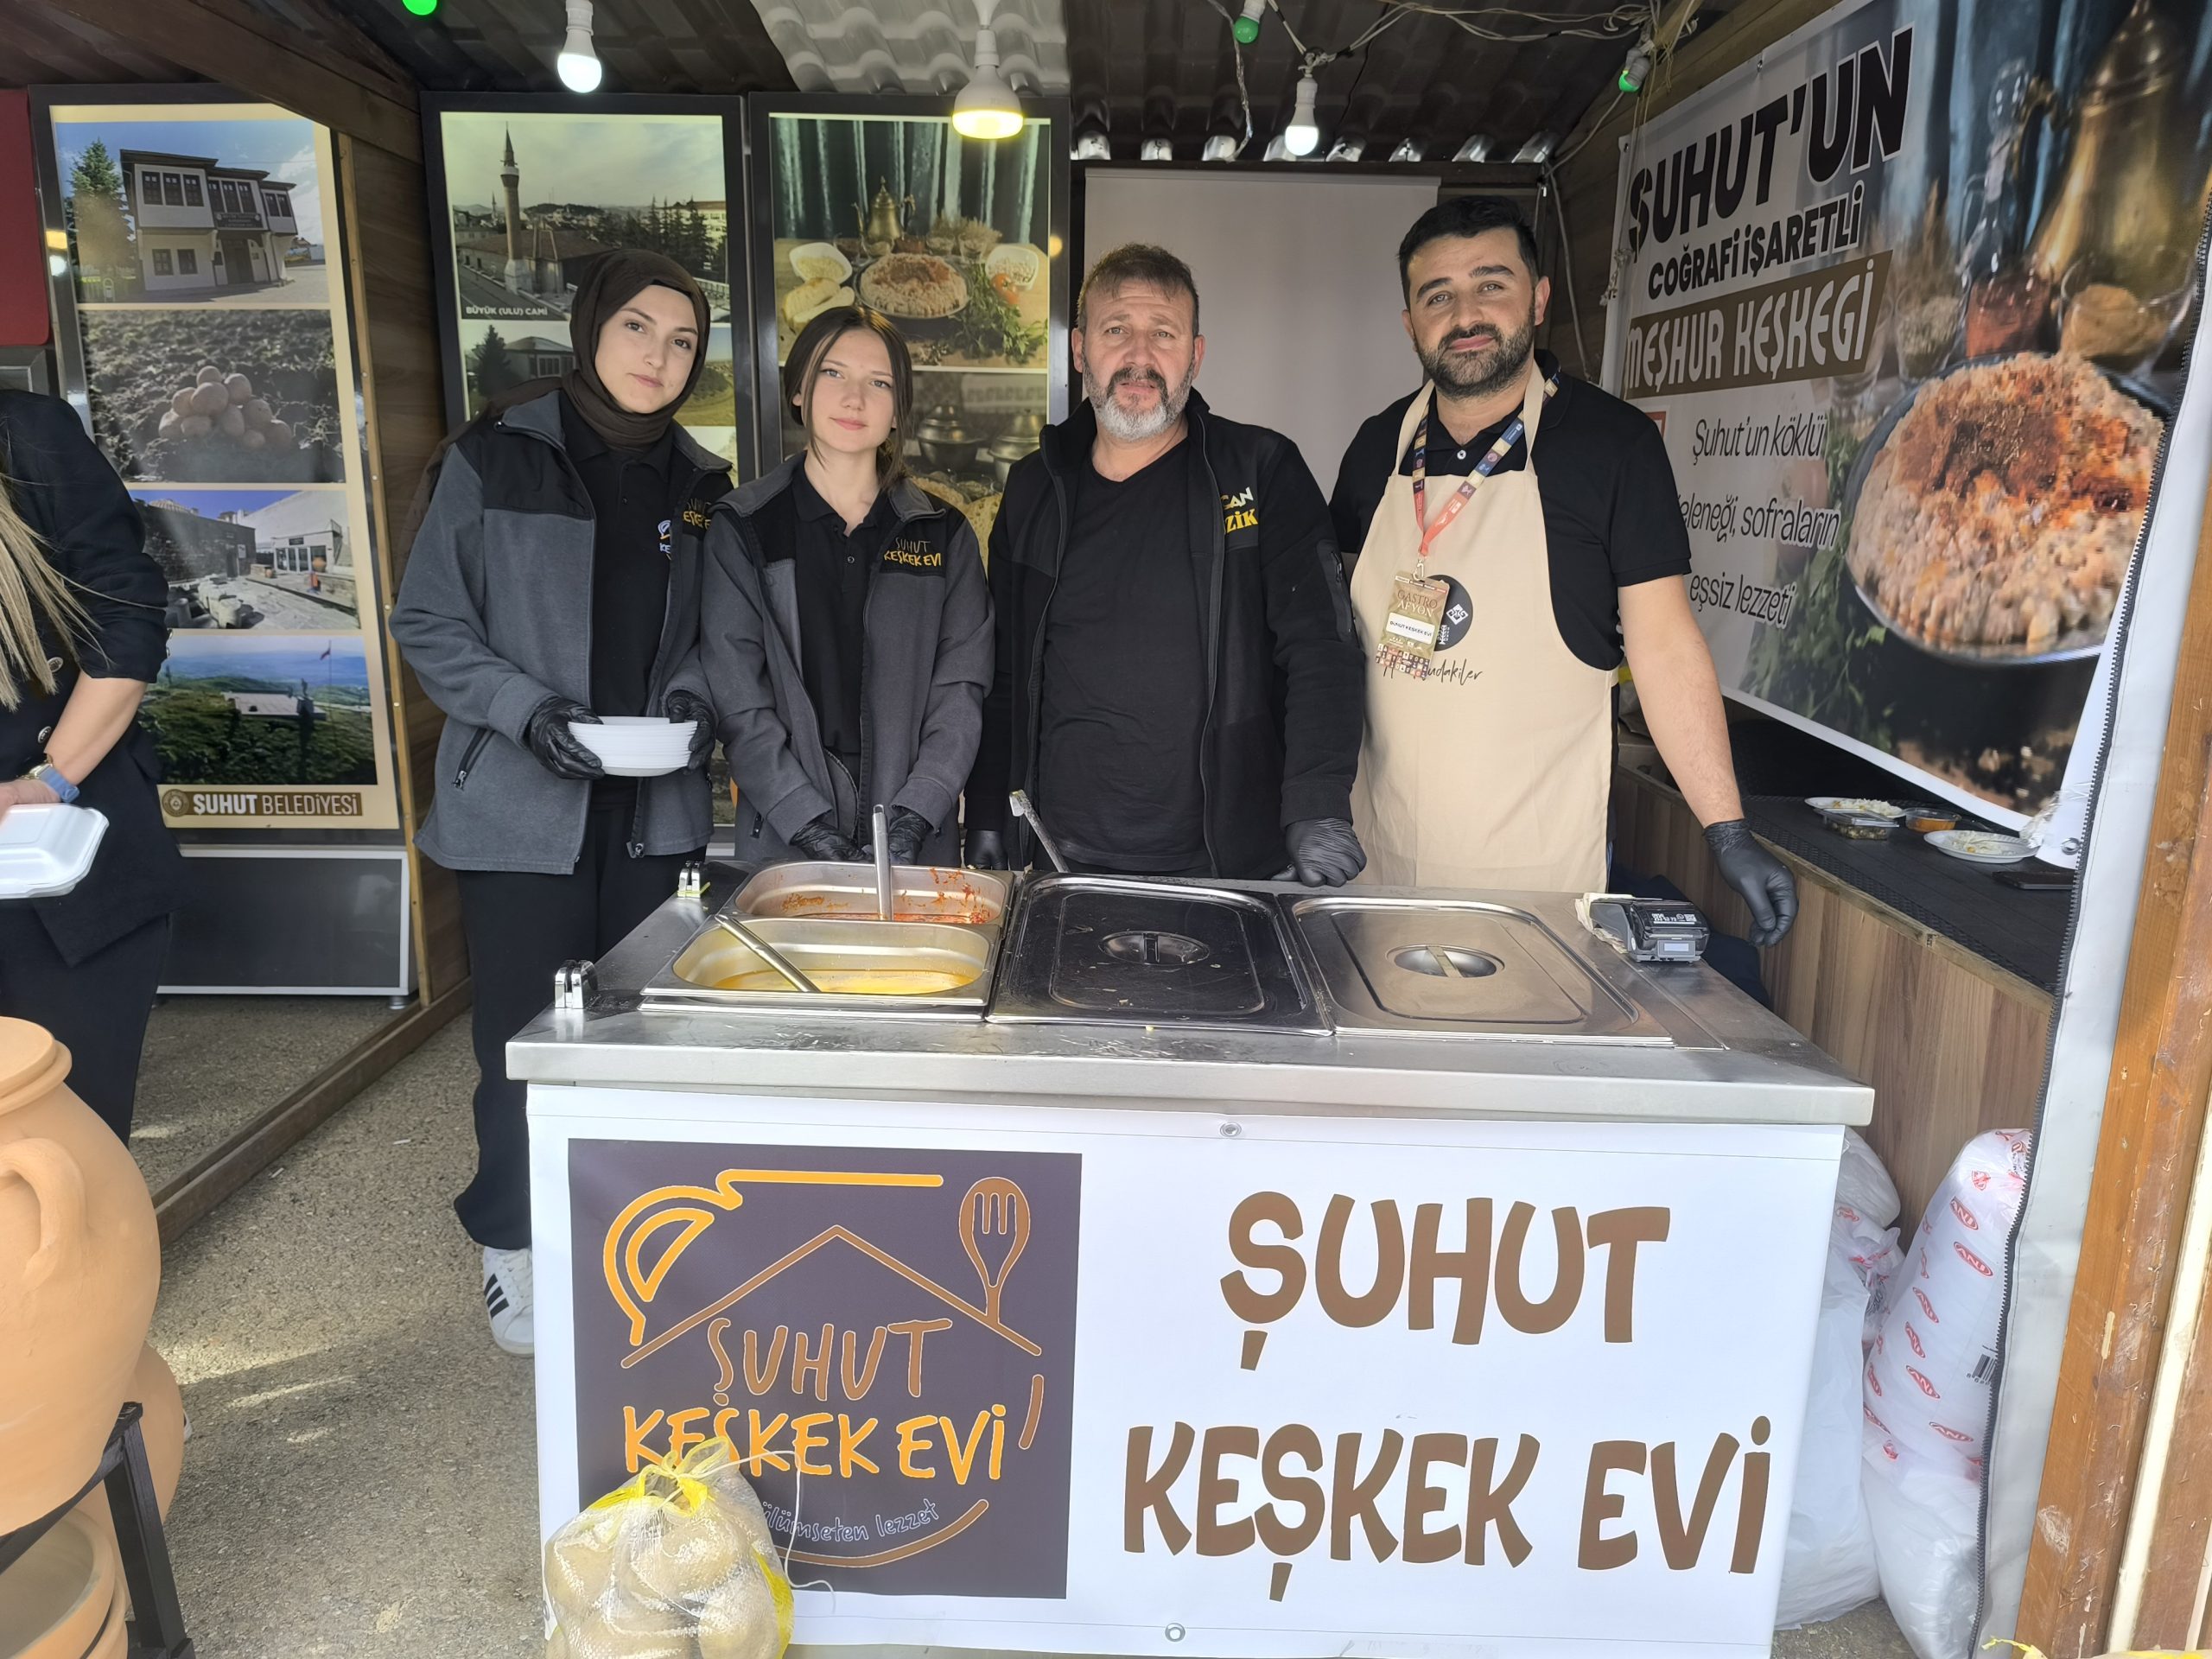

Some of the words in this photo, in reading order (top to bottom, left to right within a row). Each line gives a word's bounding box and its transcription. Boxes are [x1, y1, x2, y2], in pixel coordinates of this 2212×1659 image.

[1628, 25, 1915, 264] ŞUHUT'UN
[1628, 308, 1725, 393] MEŞHUR
[1693, 416, 1770, 466] Şuhut'un
[1770, 412, 1826, 457] köklü
[1224, 508, 1258, 534] ZİK
[1678, 493, 1738, 543] eleneği,
[1740, 497, 1841, 547] sofraların
[1396, 600, 1434, 618] AFYON
[1397, 589, 1438, 609] GASTRO
[1690, 571, 1735, 613] eşsiz
[1735, 574, 1796, 625] lezzeti
[193, 793, 258, 816] ŞUHUT
[262, 793, 358, 815] BELEDİYESİ
[1219, 1190, 1671, 1371] ŞUHUT
[707, 1318, 952, 1406] ŞUHUT
[896, 1404, 1007, 1484] EVİ
[763, 1501, 869, 1542] ülümseten
[874, 1498, 939, 1537] lezzet
[1123, 1421, 1541, 1603] KEŞKEK
[1577, 1415, 1771, 1574] EVİ
